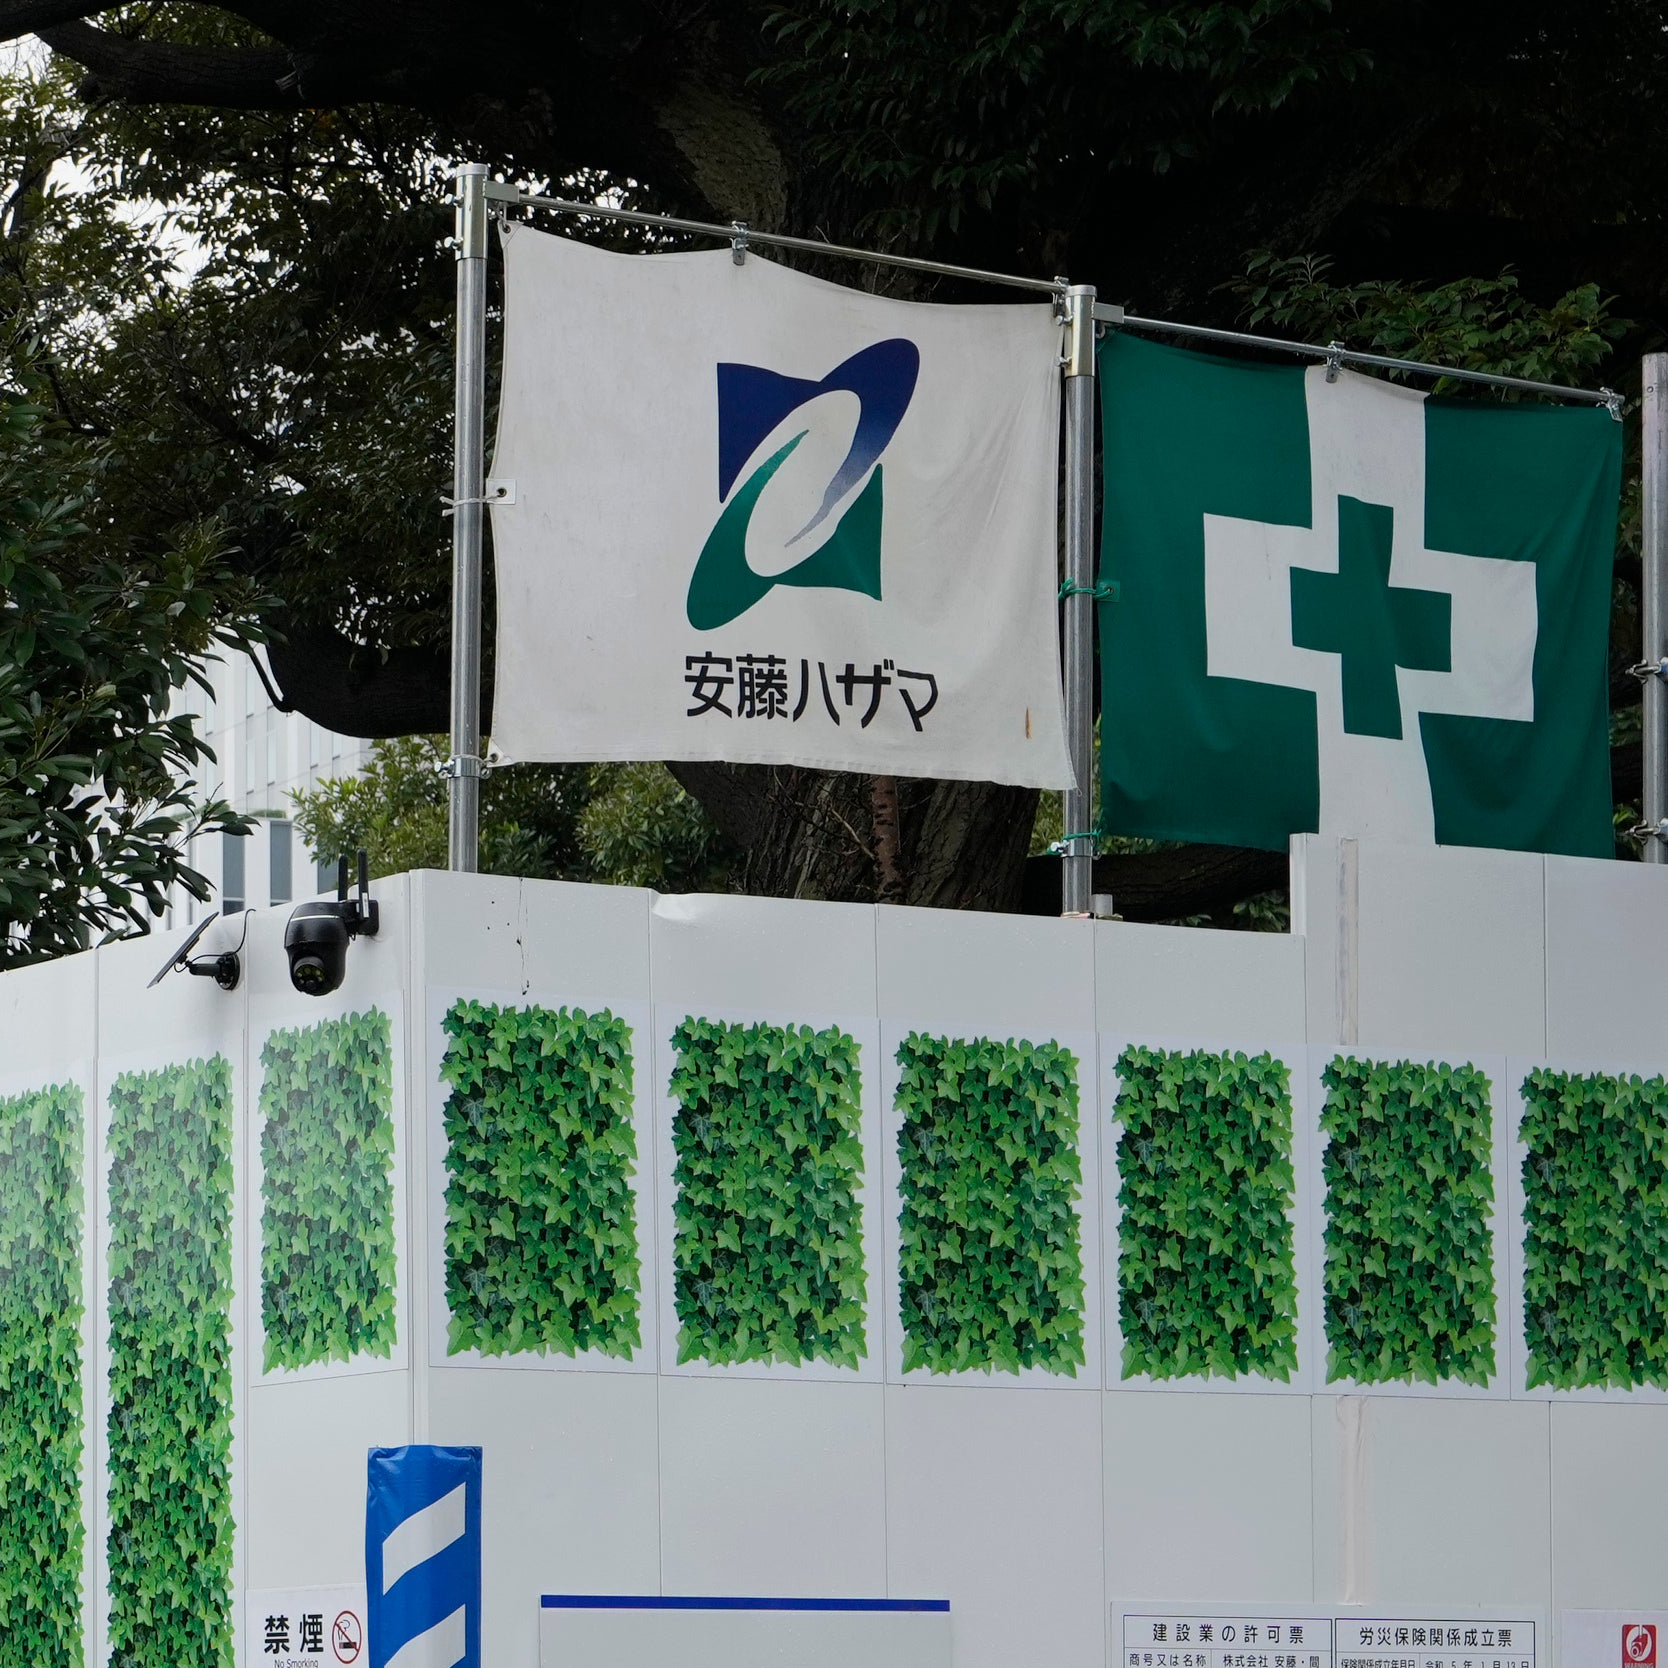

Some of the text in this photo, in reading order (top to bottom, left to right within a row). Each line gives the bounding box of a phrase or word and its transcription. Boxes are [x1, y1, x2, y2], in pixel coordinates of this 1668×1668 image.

[685, 651, 938, 732] 安藤ハザマ
[264, 1614, 324, 1654] 禁煙
[1153, 1623, 1304, 1644] 建設業の許可票
[1360, 1627, 1512, 1647] 労災保険関係成立票
[274, 1660, 284, 1668] No
[1129, 1653, 1206, 1668] 商号又は名称
[1223, 1655, 1269, 1668] 株式会社
